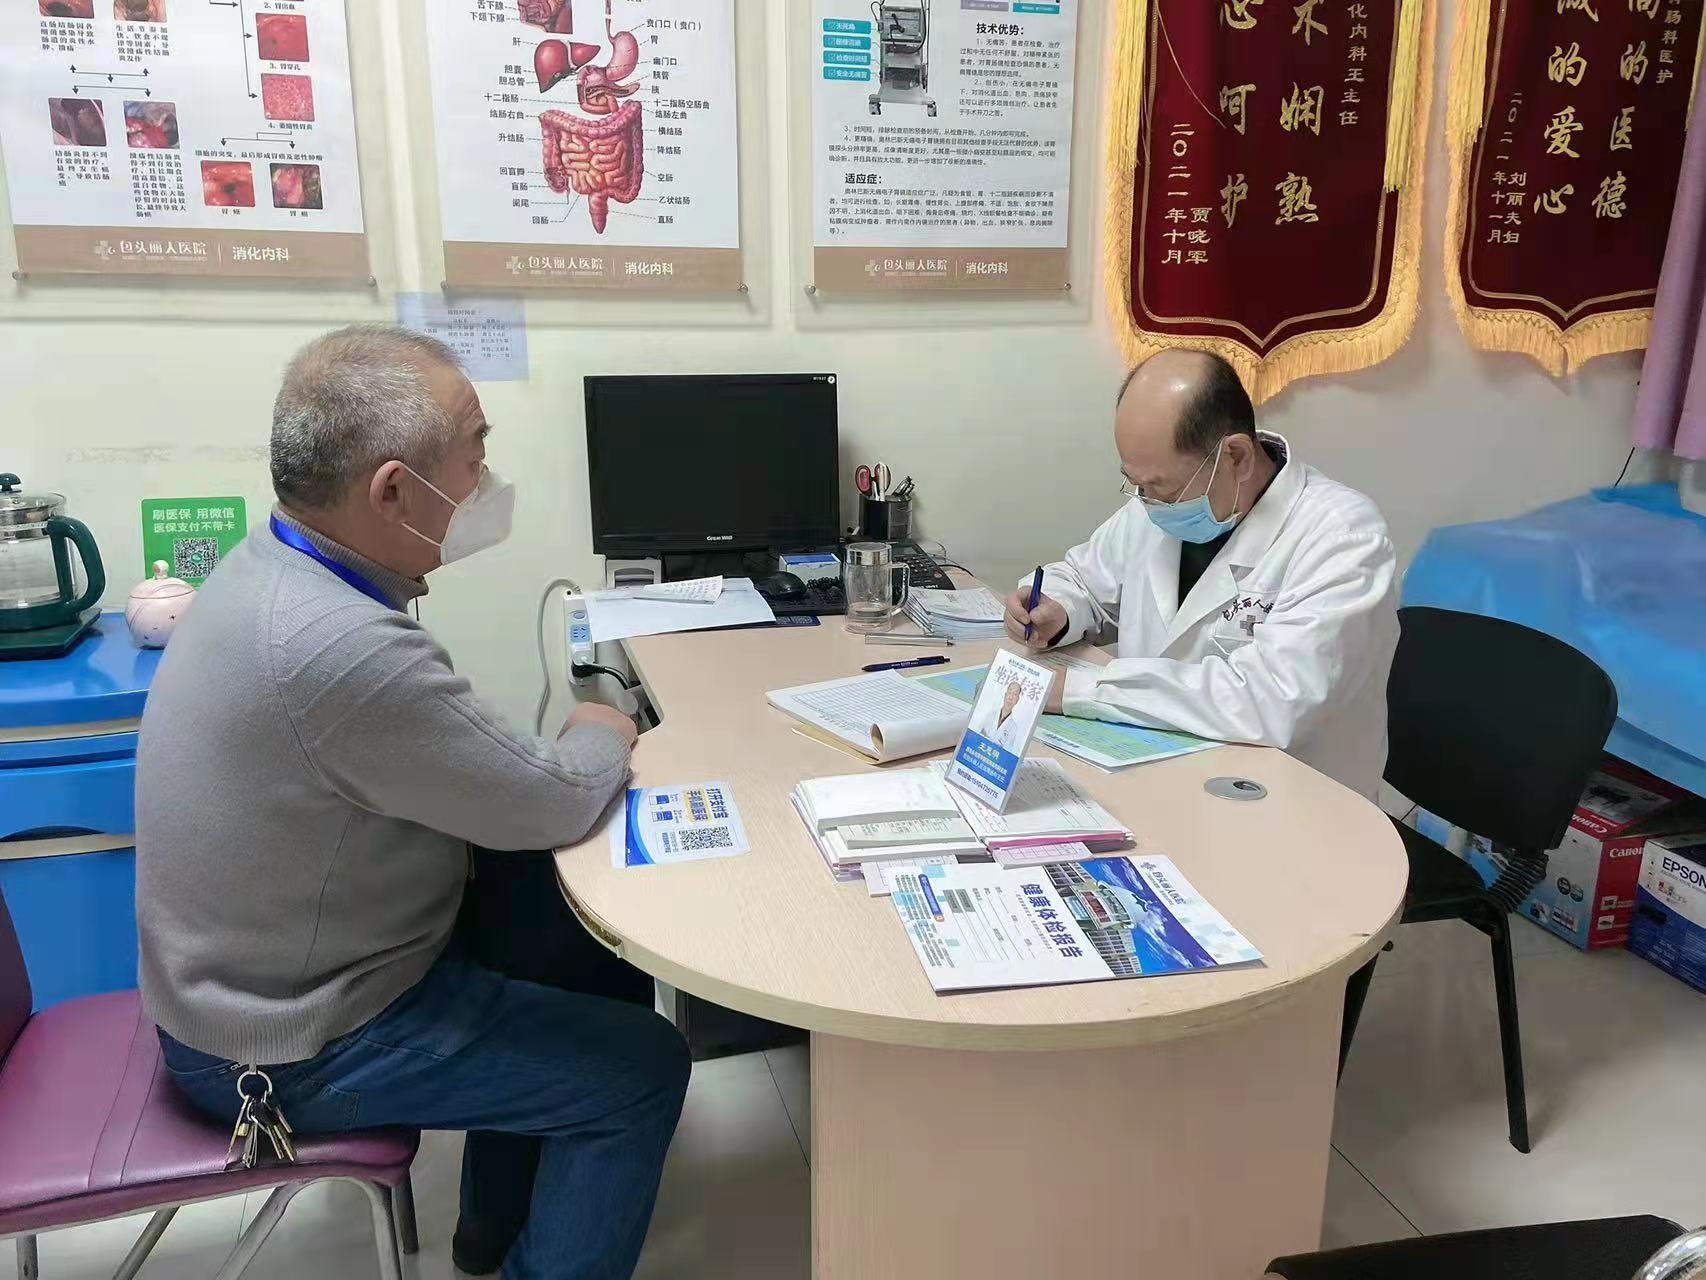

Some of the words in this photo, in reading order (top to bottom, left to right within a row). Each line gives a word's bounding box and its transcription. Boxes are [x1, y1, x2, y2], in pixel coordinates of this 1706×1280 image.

[512, 37, 521, 46] 肝
[650, 35, 658, 44] 胃
[1656, 0, 1682, 84] 肠科医护
[653, 57, 677, 66] 幽门口
[1339, 4, 1368, 126] 化内科王主任
[504, 65, 522, 74] 胆囊
[653, 71, 669, 80] 胰管
[499, 76, 526, 86] 胆总管
[652, 86, 659, 94] 胰
[484, 93, 519, 102] 十二指肠
[655, 99, 710, 109] 十二指肠空肠曲
[490, 109, 524, 119] 结肠右曲
[655, 110, 687, 119] 结肠左曲
[658, 127, 682, 136] 横结肠
[498, 134, 524, 142] 升结肠
[657, 146, 682, 155] 降结肠
[657, 173, 674, 182] 空肠
[511, 182, 528, 191] 盲肠
[512, 199, 529, 207] 阑尾
[658, 196, 690, 205] 乙状结肠
[1502, 172, 1526, 244] 刘丽夫妇
[532, 216, 549, 224] 回肠
[658, 216, 673, 224] 直肠
[1185, 207, 1212, 264] 贾晓军
[120, 240, 208, 255] 包头丽人医院
[232, 246, 289, 261] 消化内科
[528, 256, 603, 270] 包头丽人医院
[884, 258, 947, 271] 包头丽人医院
[966, 262, 1008, 274] 消化内科
[625, 262, 673, 275] 消化内科
[152, 508, 191, 520] 刷医保
[196, 507, 235, 519] 用微信
[154, 521, 235, 533] 医保支付不带卡
[706, 788, 729, 819] 打开支付宝
[1663, 857, 1706, 889] EPSON
[1020, 884, 1083, 958] 健康体检报告
